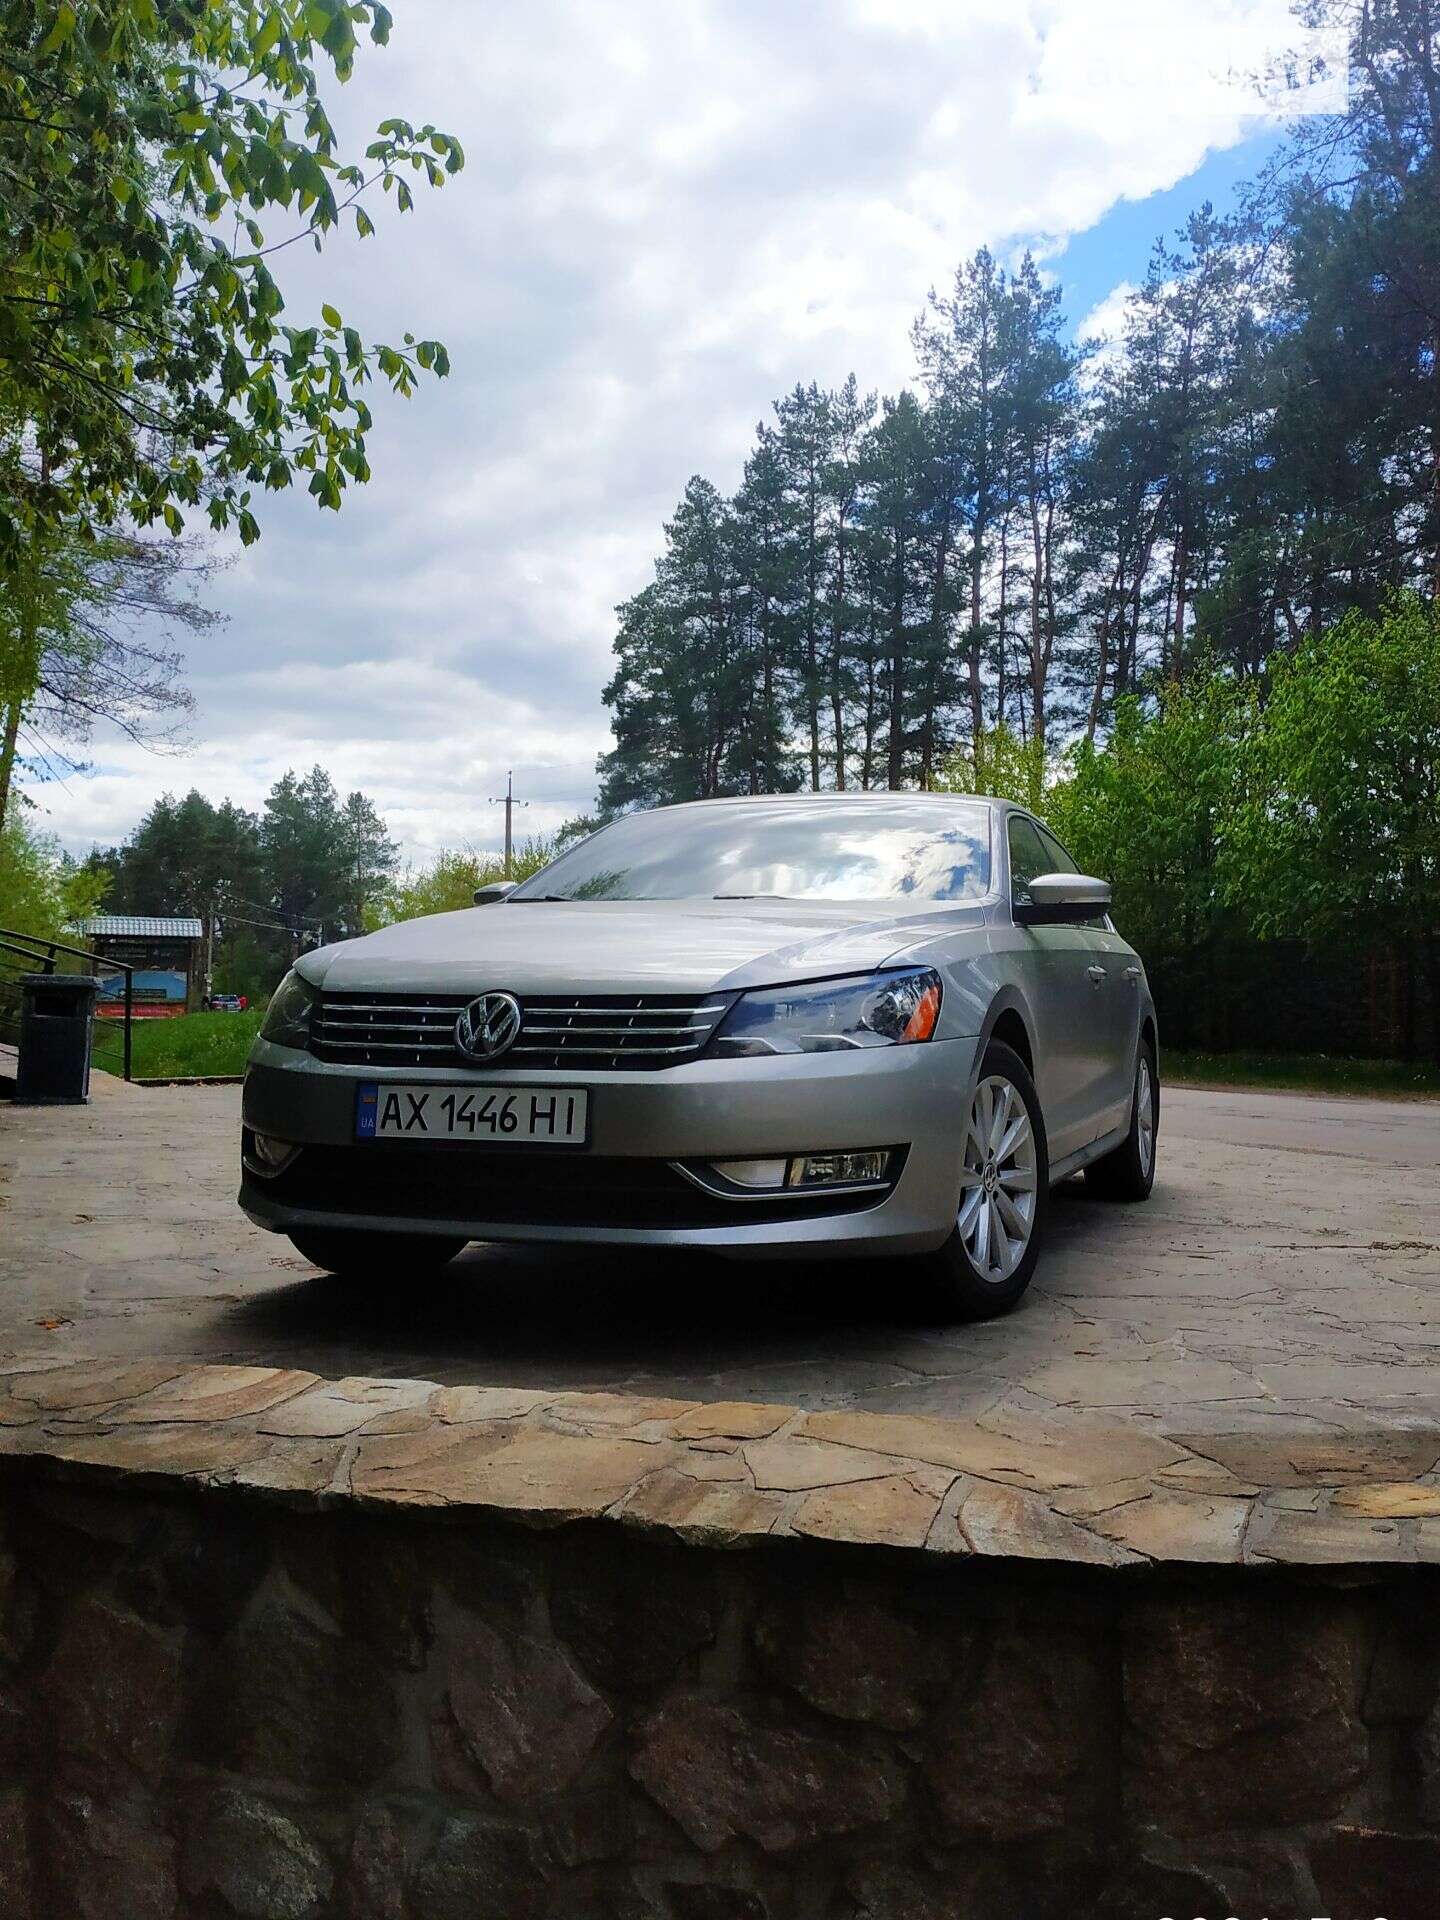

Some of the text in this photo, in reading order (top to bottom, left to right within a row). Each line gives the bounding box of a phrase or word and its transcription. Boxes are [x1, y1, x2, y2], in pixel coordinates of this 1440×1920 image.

[455, 993, 519, 1056] VW
[360, 1117, 374, 1128] UA
[379, 1092, 575, 1135] AX 1446 HI
